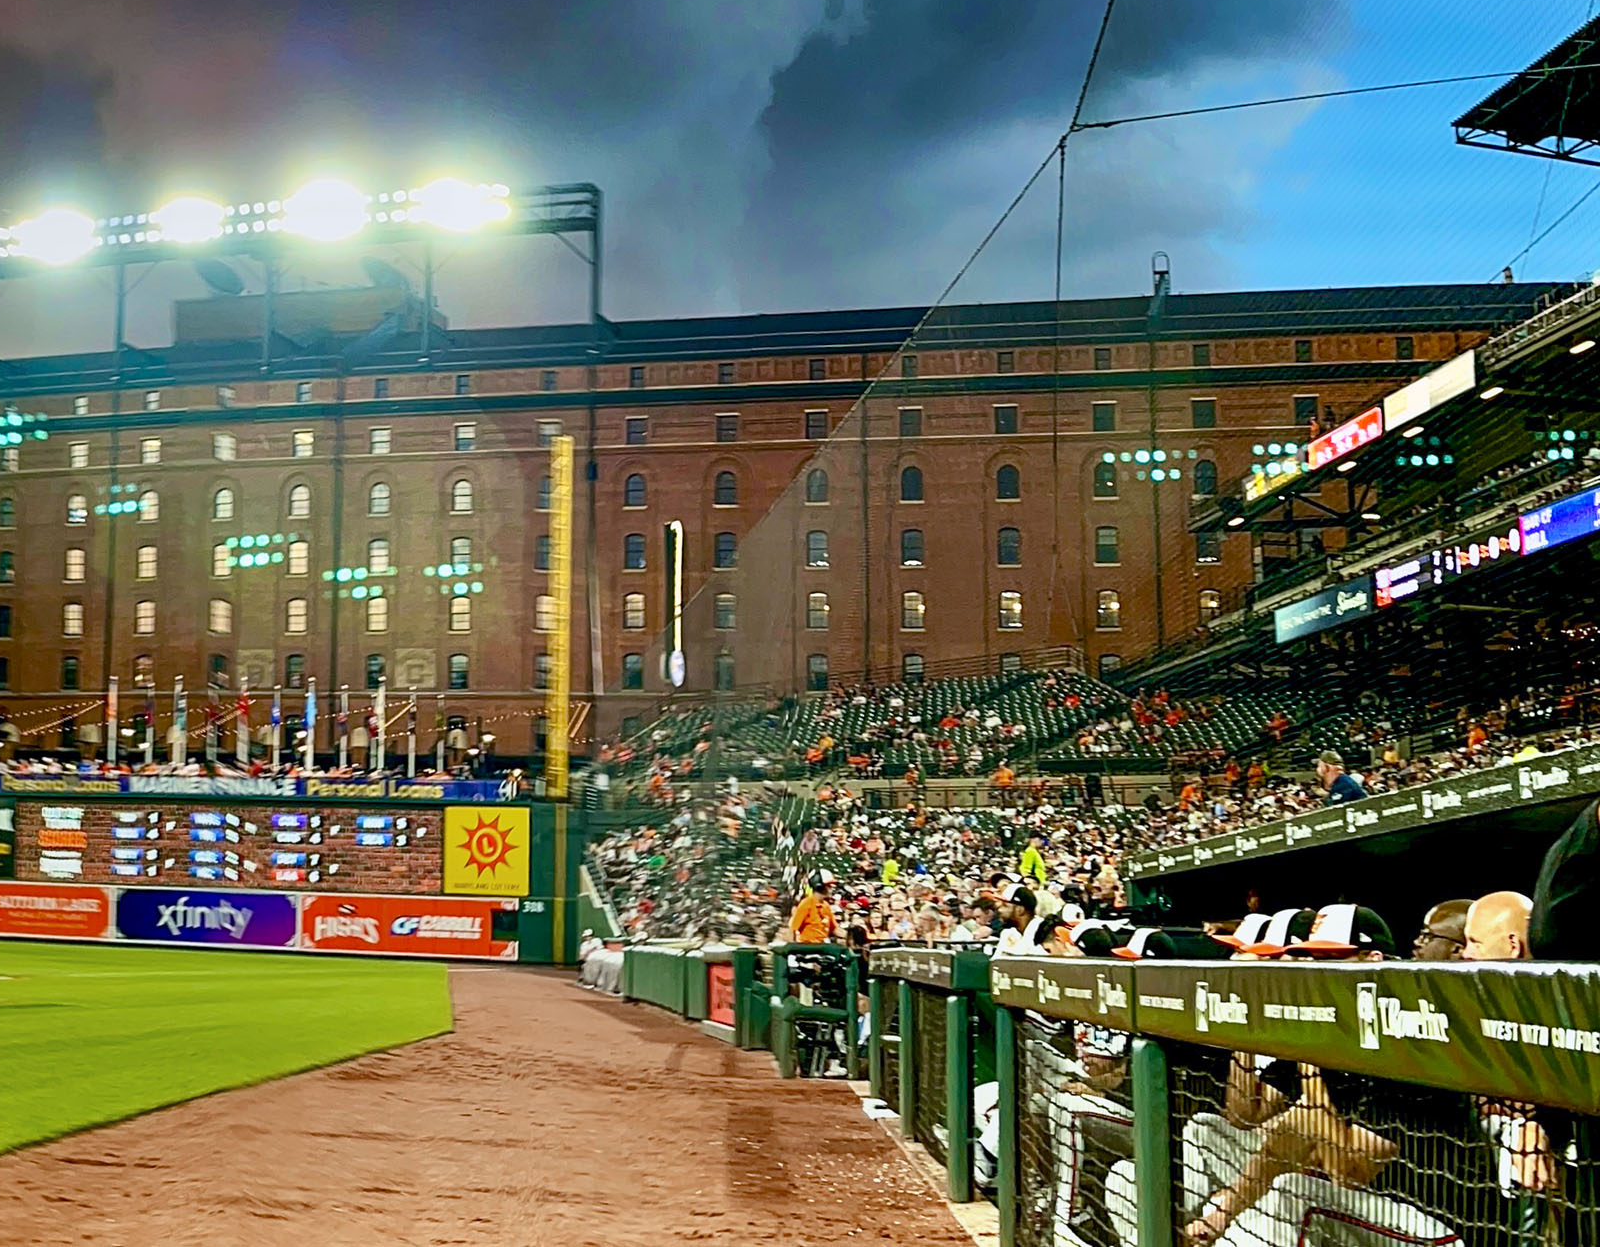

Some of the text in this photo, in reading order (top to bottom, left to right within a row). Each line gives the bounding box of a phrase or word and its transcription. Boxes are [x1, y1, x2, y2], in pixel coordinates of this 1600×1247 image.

[1, 775, 68, 792] Personal
[306, 779, 384, 798] Personal
[389, 781, 444, 799] Loans
[482, 837, 493, 852] L
[309, 853, 320, 866] 7
[156, 896, 254, 940] xfinity
[419, 915, 483, 932] CARROLL
